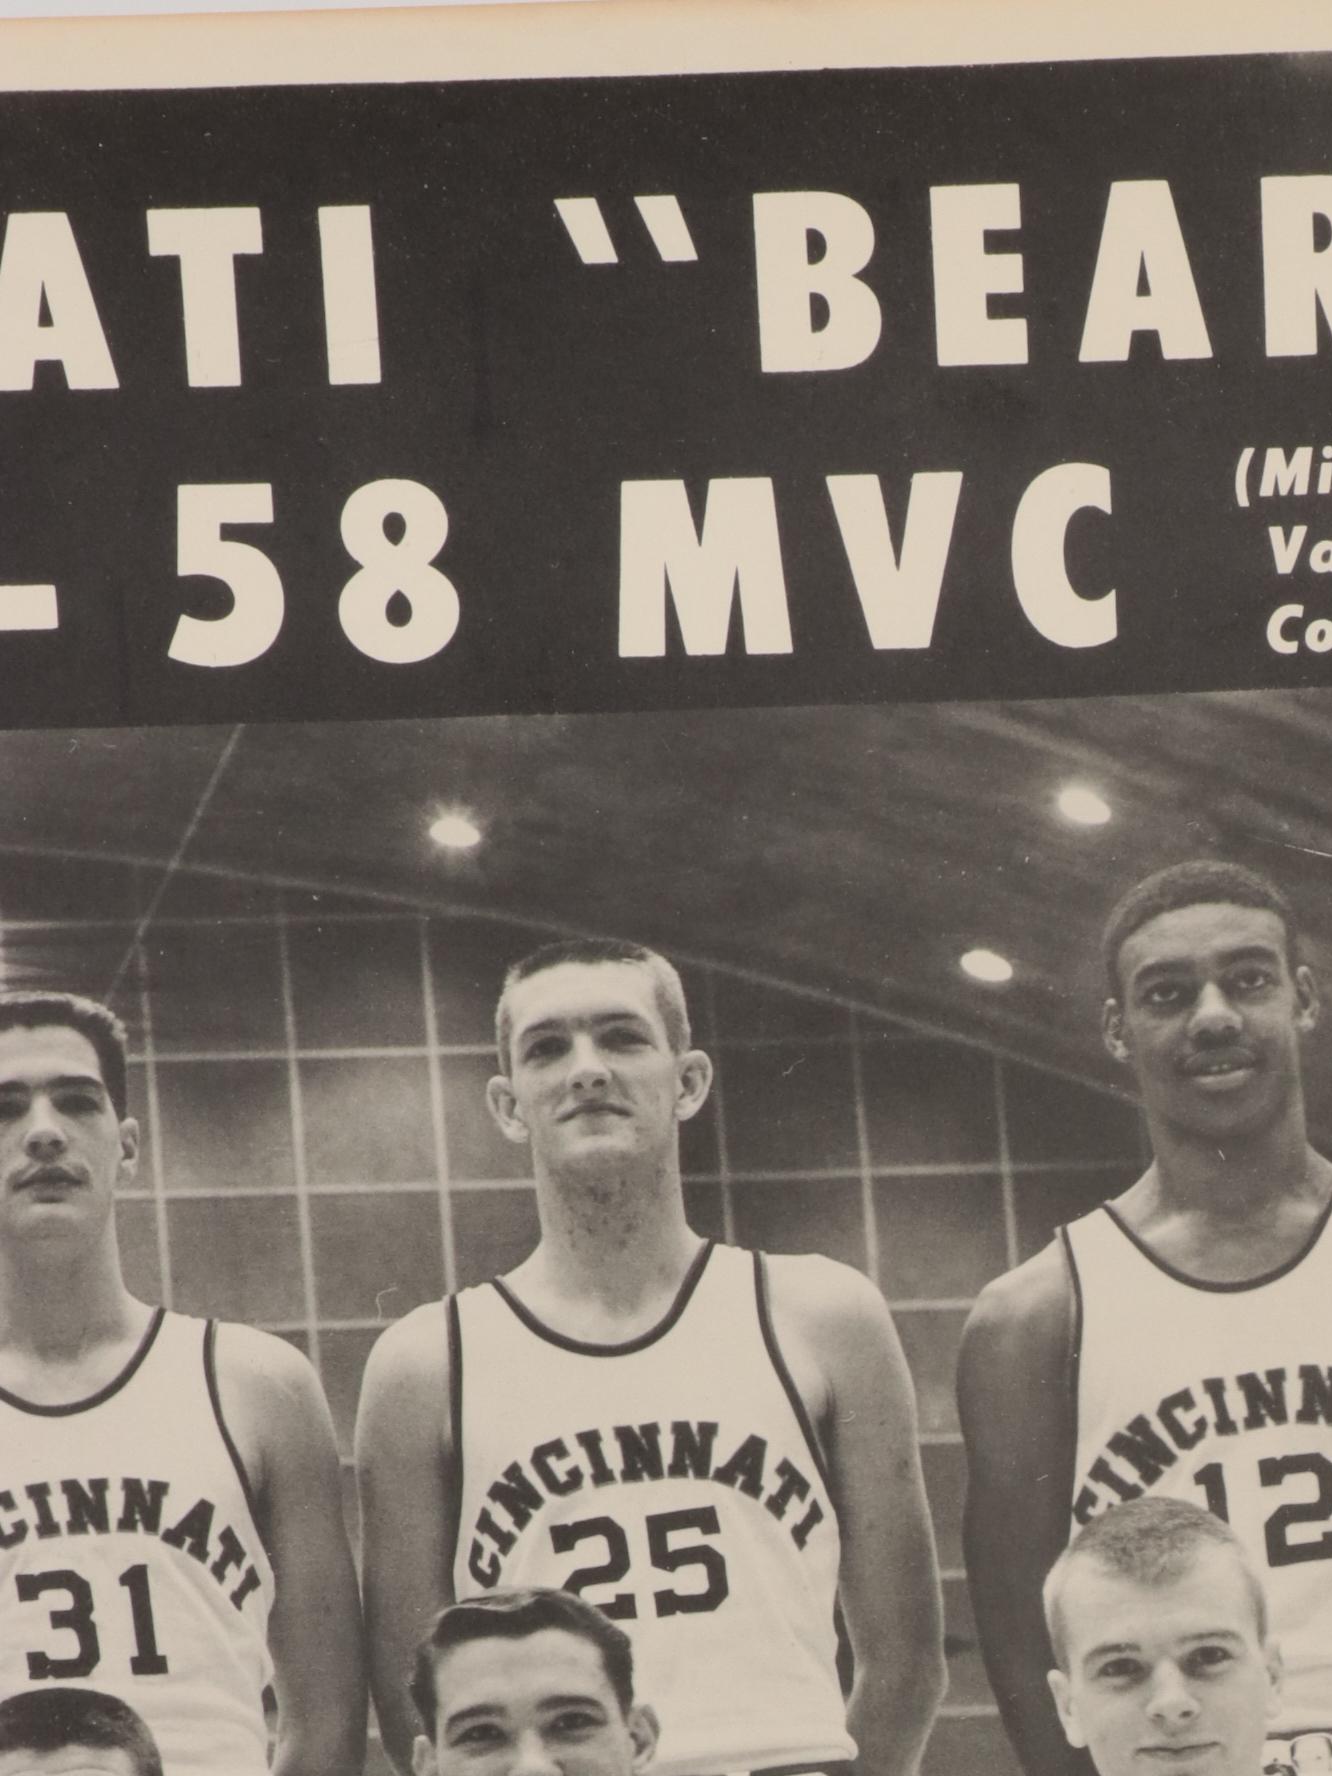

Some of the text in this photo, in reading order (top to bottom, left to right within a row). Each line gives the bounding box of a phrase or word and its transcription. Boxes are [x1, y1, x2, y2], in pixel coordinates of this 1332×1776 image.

[0, 204, 382, 392] ATI
[167, 462, 1118, 668] 58 MVC
[468, 1420, 824, 1589] CINCINNATI
[549, 1505, 730, 1620] 25
[14, 1563, 169, 1680] 31
